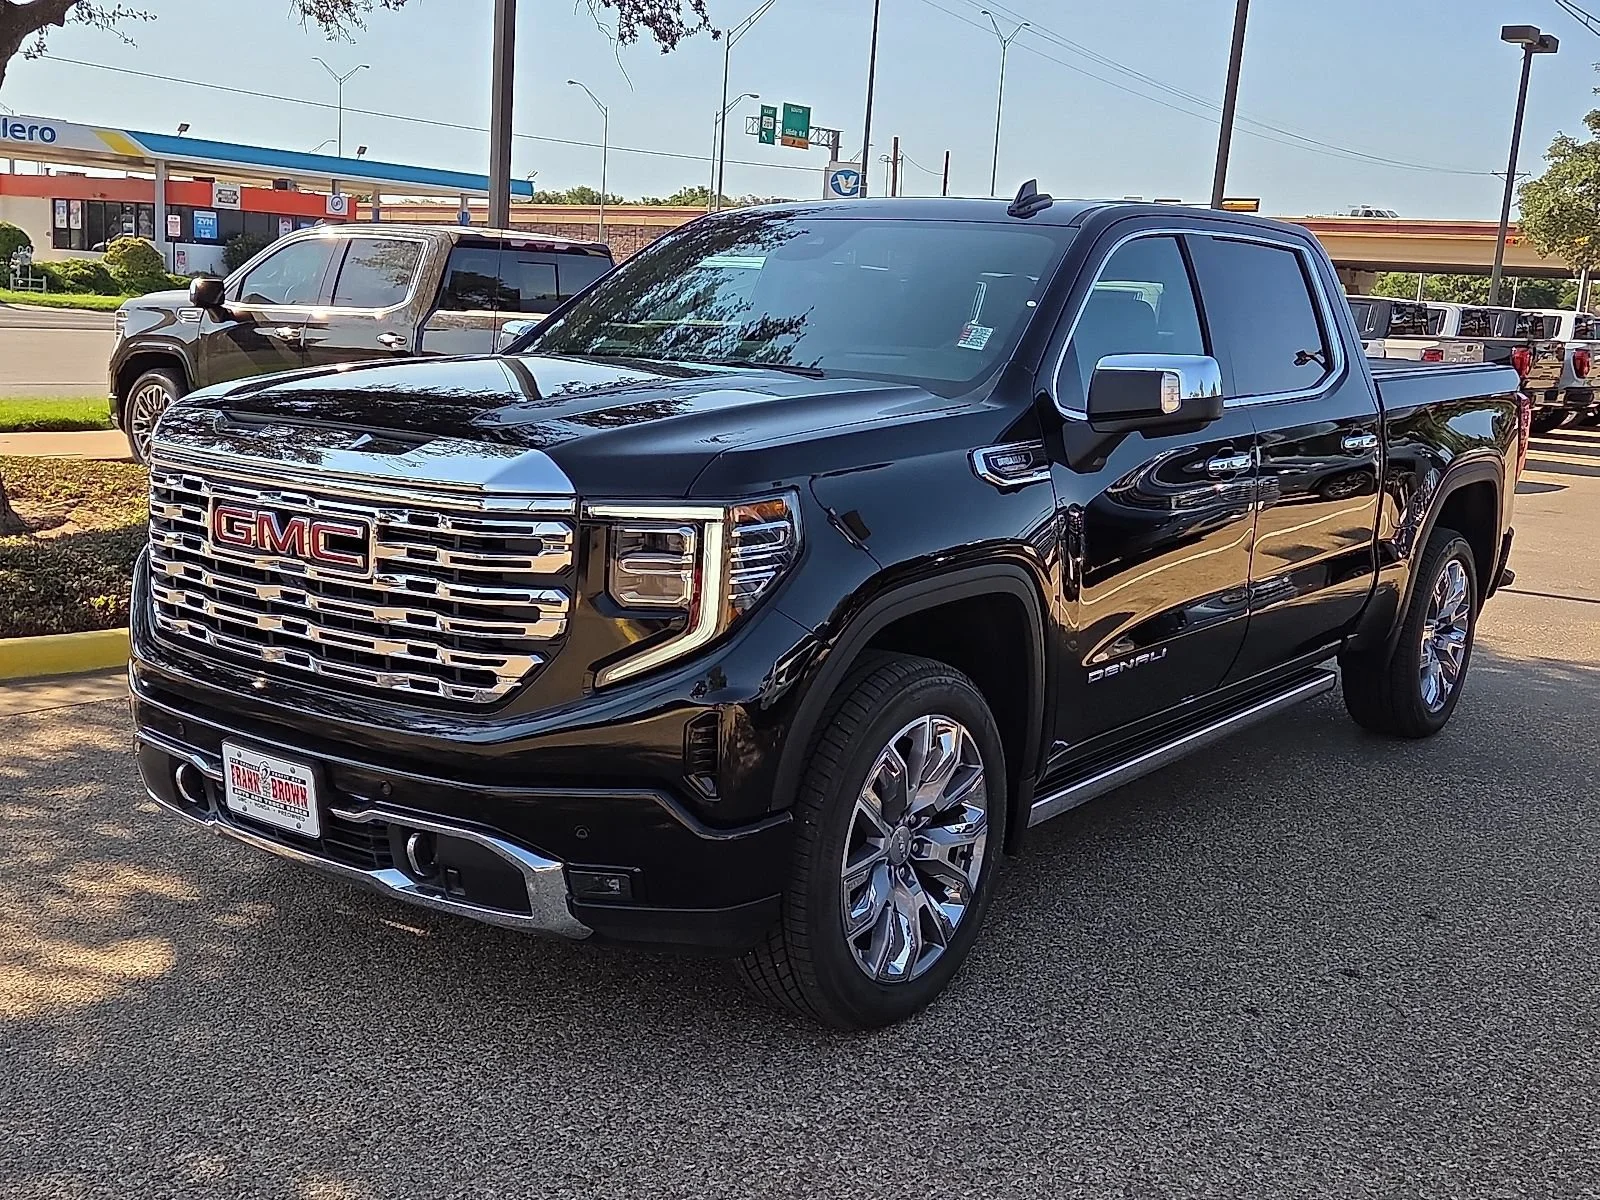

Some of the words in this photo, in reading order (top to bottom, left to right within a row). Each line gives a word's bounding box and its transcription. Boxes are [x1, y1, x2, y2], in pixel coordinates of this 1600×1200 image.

[2, 117, 56, 143] lero
[214, 505, 365, 569] GMC
[1088, 647, 1167, 684] DENALI
[230, 764, 261, 795] FRANK
[270, 777, 308, 810] BROWN
